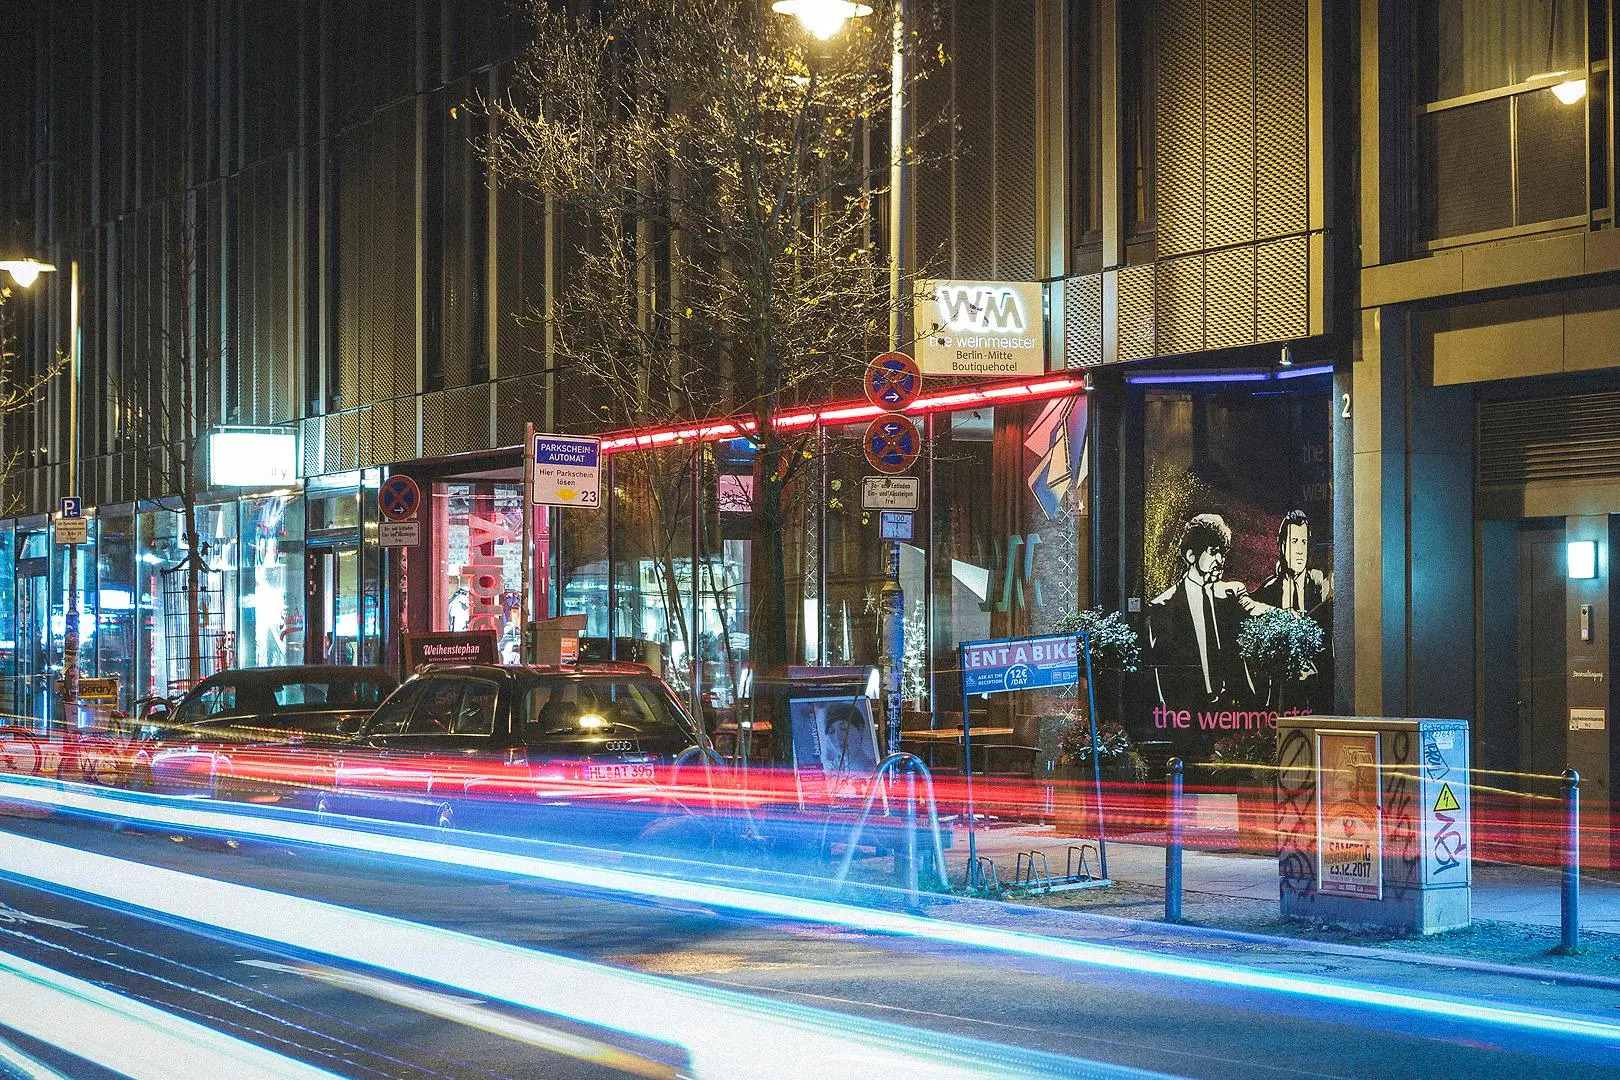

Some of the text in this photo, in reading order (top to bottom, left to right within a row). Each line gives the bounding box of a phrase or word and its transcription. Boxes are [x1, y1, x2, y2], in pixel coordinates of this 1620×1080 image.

[939, 287, 1025, 329] WM
[956, 336, 1037, 348] weinmeister
[952, 362, 1018, 374] Boutiquehotel
[1341, 394, 1351, 418] 2
[540, 443, 594, 454] PARKSCHEIN-
[548, 453, 586, 463] AUTOMAT
[556, 469, 594, 478] Parkschein
[581, 490, 597, 503] 23
[64, 500, 75, 516] P
[892, 514, 905, 522] 100
[423, 642, 480, 656] Weihenstephan
[1014, 647, 1028, 663] A
[1032, 642, 1077, 661] BIKE
[1009, 668, 1028, 679] 12€
[1010, 678, 1028, 686] /DAY
[1153, 703, 1191, 729] the
